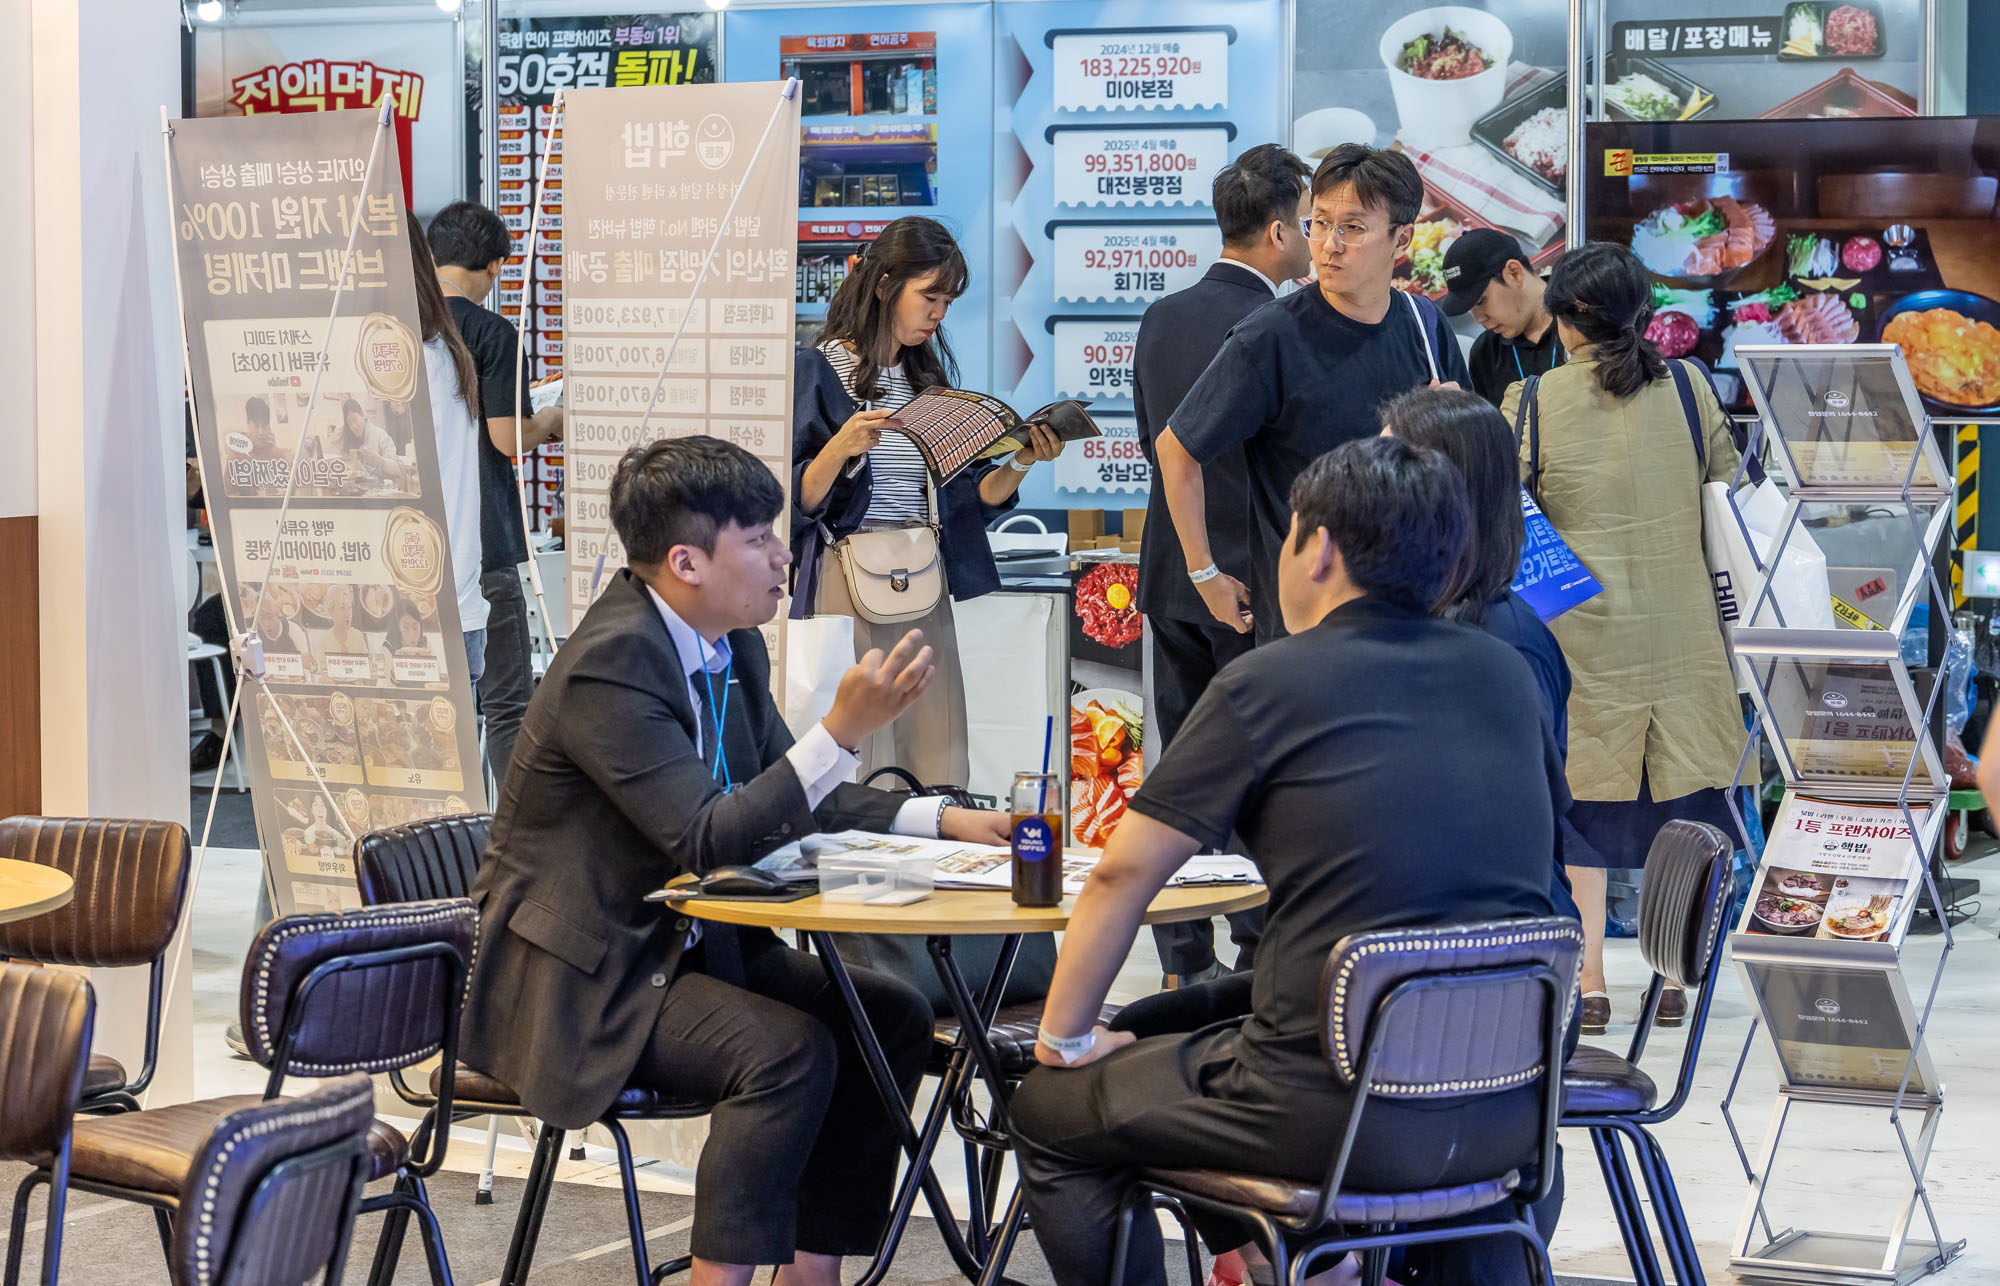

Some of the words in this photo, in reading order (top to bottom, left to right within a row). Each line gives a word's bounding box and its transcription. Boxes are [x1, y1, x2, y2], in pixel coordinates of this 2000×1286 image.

[525, 31, 550, 48] 연어
[552, 29, 611, 47] 프랜차이즈
[615, 26, 655, 46] 부동의
[657, 25, 681, 44] 1위
[1101, 44, 1136, 55] 2024년
[1139, 43, 1160, 54] 12월
[1163, 42, 1180, 54] 매출
[499, 52, 609, 95] 50호점
[614, 49, 698, 88] 돌파!
[1080, 57, 1202, 79] 183,225,920원
[236, 62, 422, 119] 전액면제
[1106, 80, 1173, 99] 미아본점
[1104, 140, 1139, 151] 2025년
[1142, 139, 1157, 150] 4월
[1160, 139, 1176, 150] 매출
[1084, 153, 1197, 176] 99,351,800원
[1098, 176, 1182, 195] 대전봉명점
[1104, 236, 1139, 247] 2025년
[1142, 235, 1157, 246] 4월
[1160, 235, 1176, 246] 매출
[1085, 249, 1197, 271] 92,971,000원
[1114, 272, 1165, 291] 회기점
[1084, 345, 1134, 366] 90,97
[1084, 440, 1143, 463] 85,689
[1834, 602, 1859, 622] #FR2
[1794, 818, 1821, 833] 1등
[1827, 823, 1912, 840] 프랜차이즈
[1841, 841, 1868, 853] 핵밥
